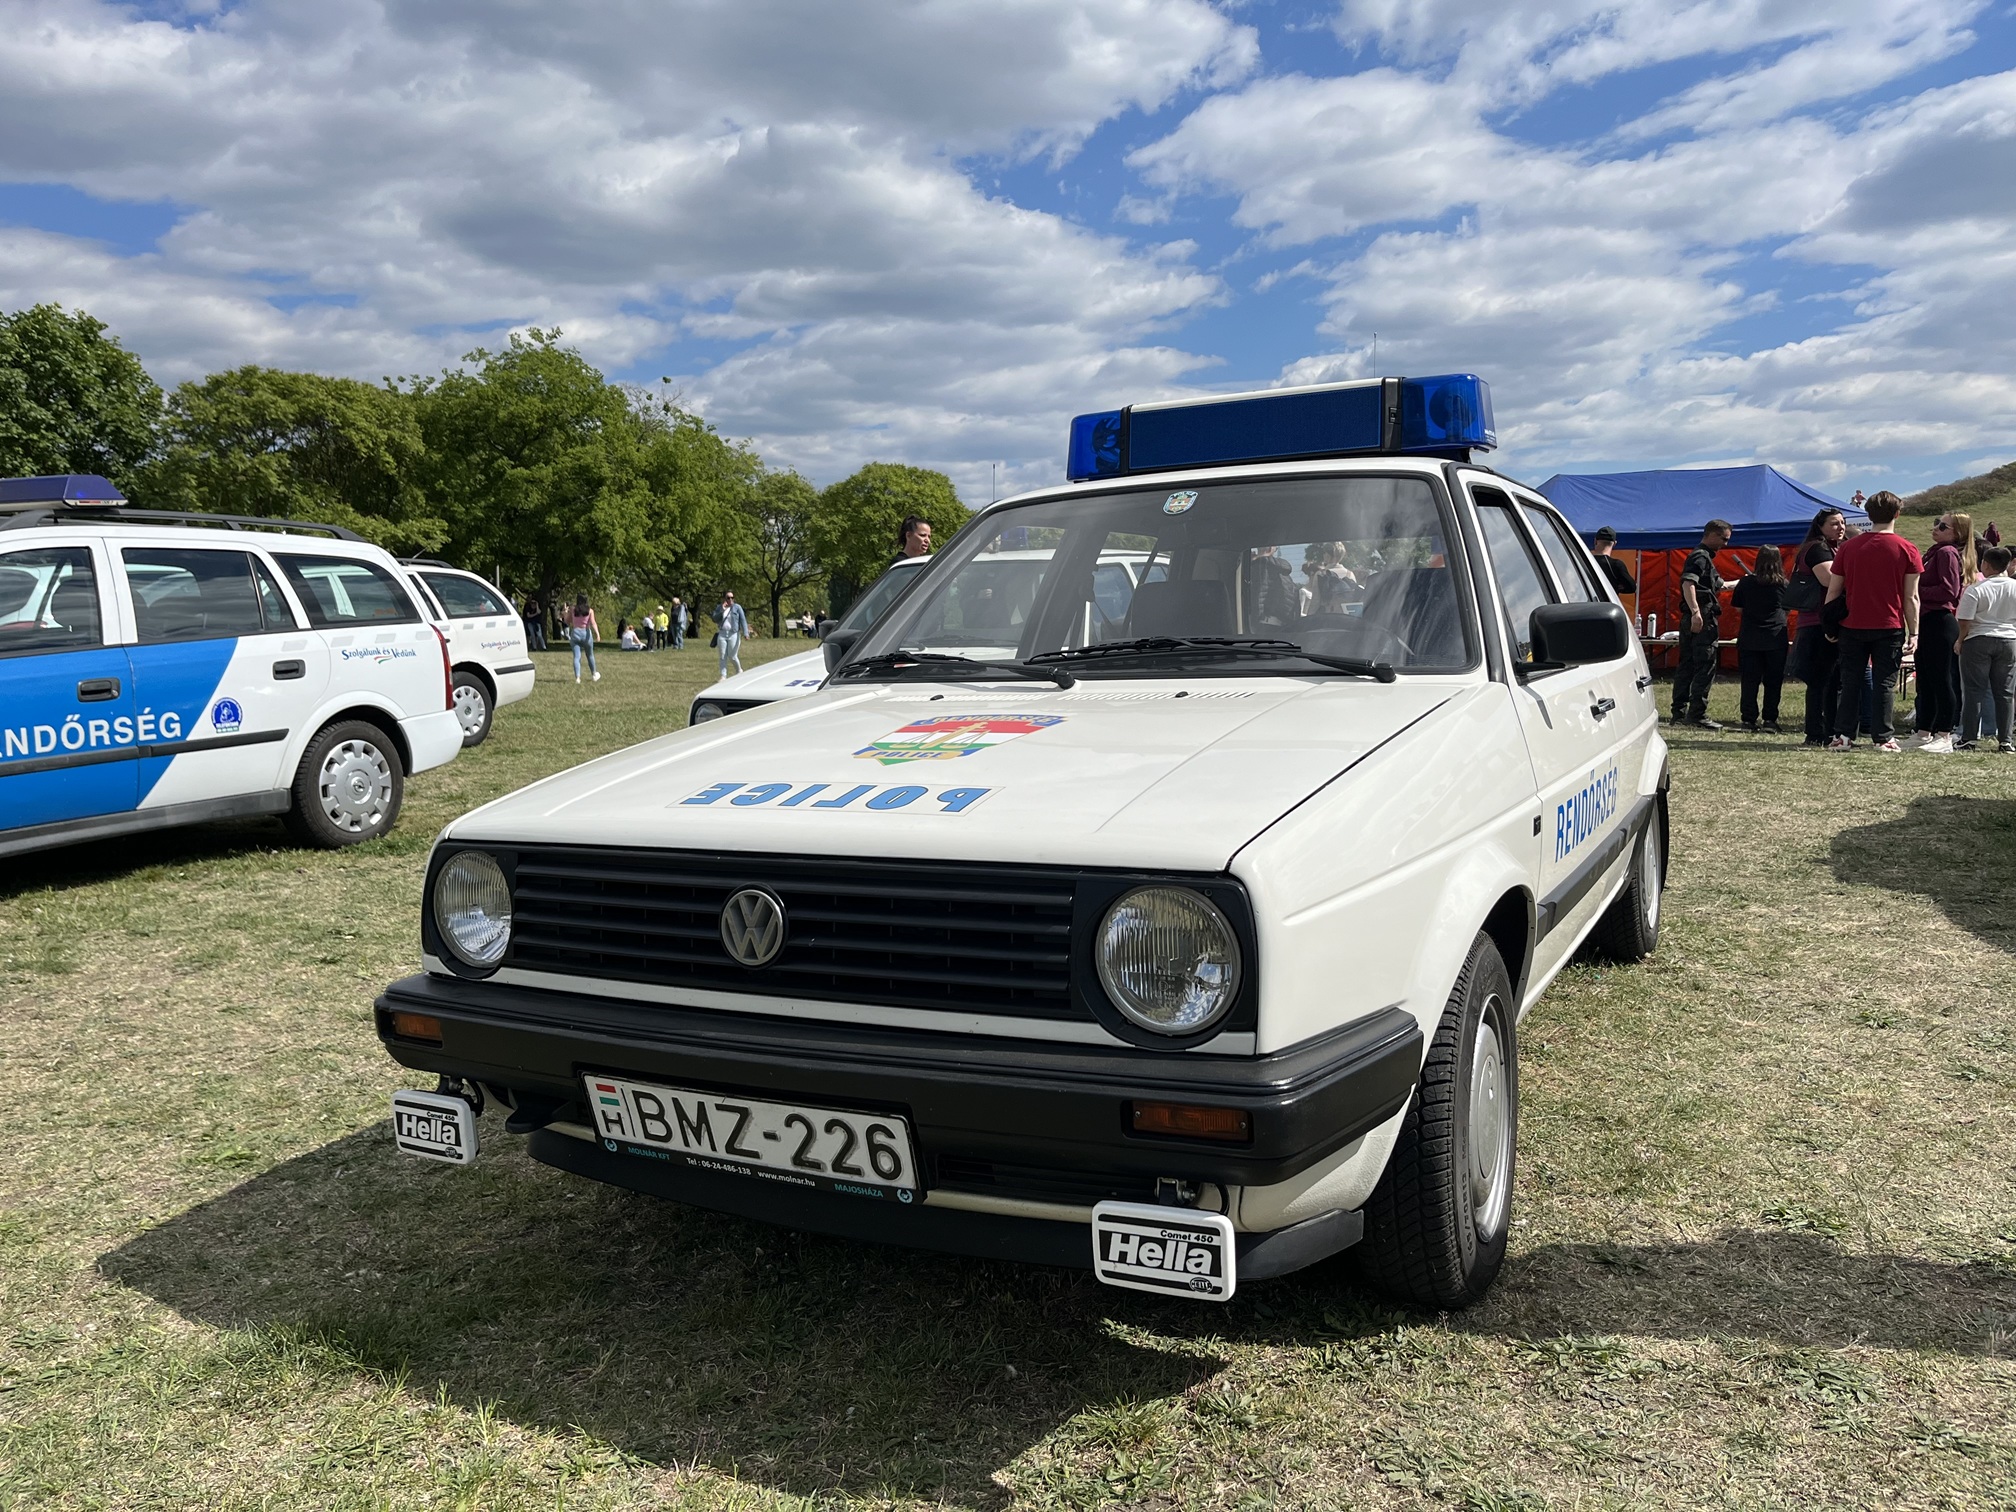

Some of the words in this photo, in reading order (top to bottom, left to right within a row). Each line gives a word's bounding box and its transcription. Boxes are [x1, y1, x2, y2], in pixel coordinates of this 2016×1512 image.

[341, 647, 382, 660] Szolgálunk
[0, 708, 181, 758] NDŐRSÉG
[872, 751, 948, 759] POLICE
[679, 782, 993, 813] POLICE
[1555, 757, 1618, 863] RENDŐRSÉG
[426, 1111, 443, 1120] Comet
[444, 1114, 455, 1122] 450
[401, 1113, 456, 1145] Hella
[601, 1109, 626, 1136] H
[631, 1089, 903, 1181] BMZ-226
[757, 1171, 816, 1188] www.molnar.hu
[834, 1183, 884, 1198] MAJOSHÁZA
[1160, 1229, 1191, 1241] Comet
[1194, 1234, 1214, 1244] 450
[1108, 1232, 1213, 1275] Hella
